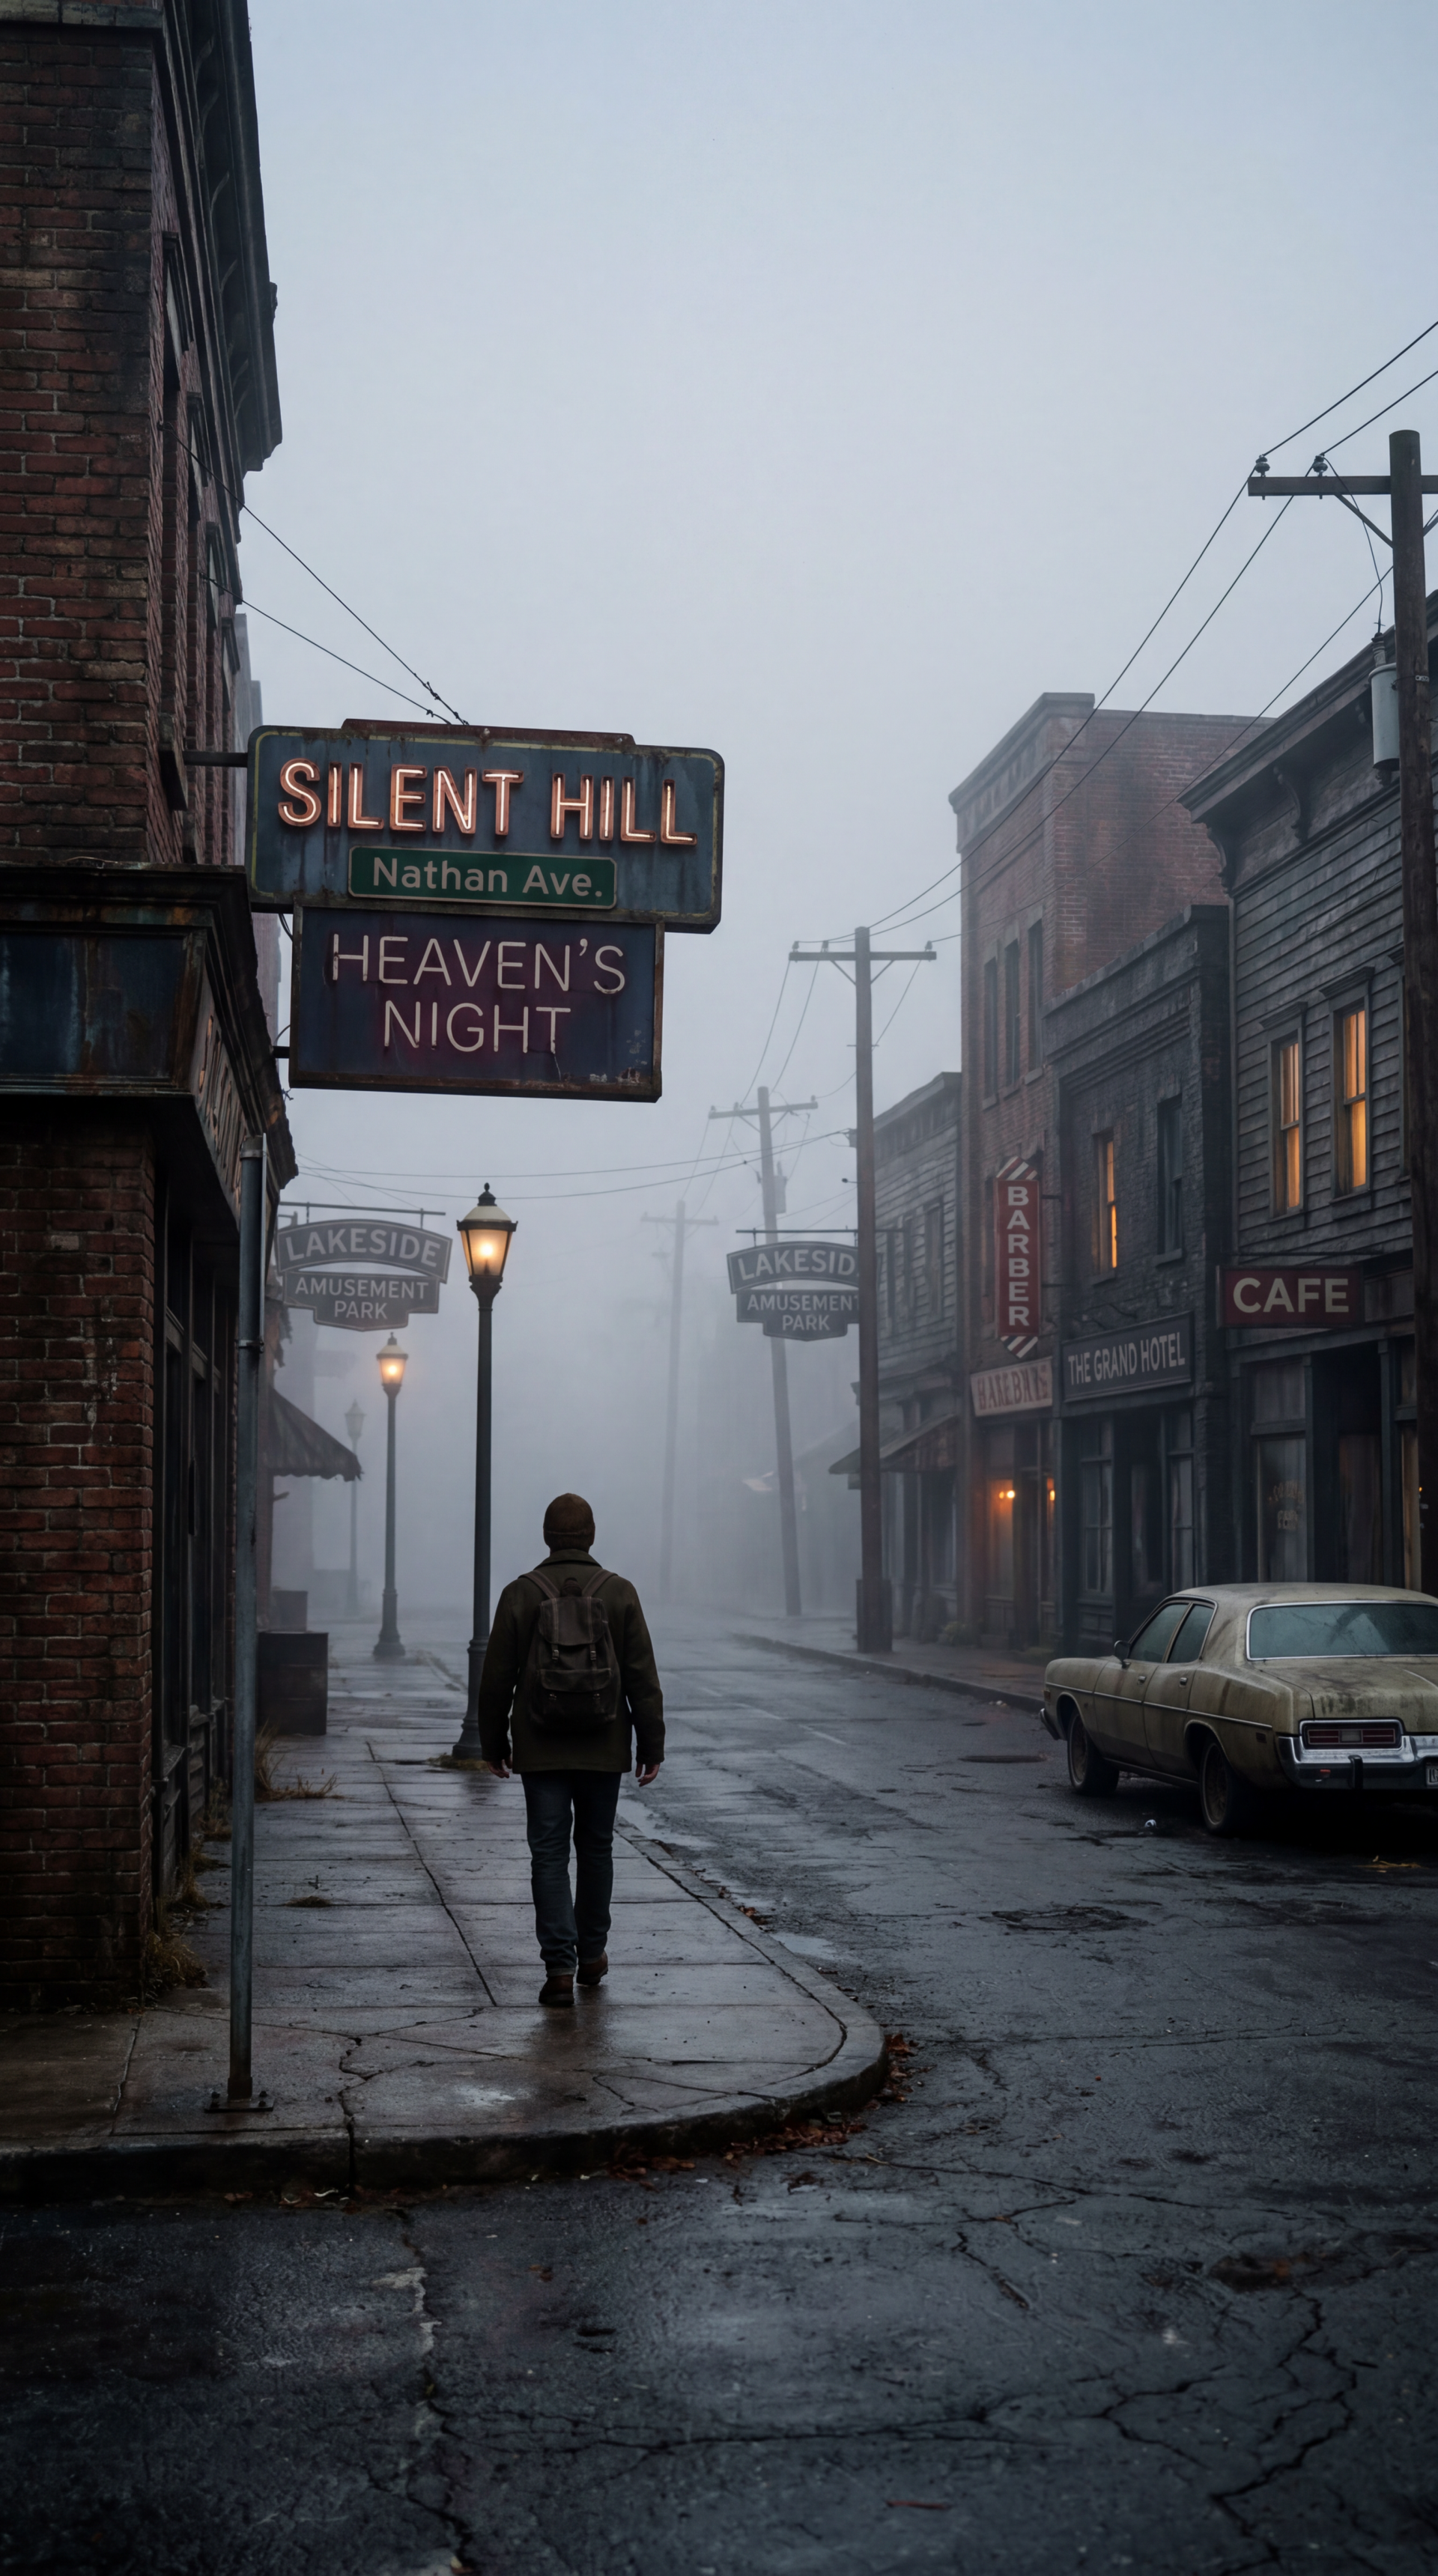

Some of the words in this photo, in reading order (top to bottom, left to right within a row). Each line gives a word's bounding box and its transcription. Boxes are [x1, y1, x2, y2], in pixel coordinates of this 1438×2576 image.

[278, 758, 524, 835] SILENT
[550, 772, 697, 845] HILL
[373, 857, 508, 893] Nathan
[522, 865, 602, 897] Ave.
[333, 934, 625, 994] HEAVEN'S
[383, 1000, 571, 1054] NIGHT
[285, 1228, 441, 1267] LAKESIDE
[738, 1249, 859, 1281] LAKESID
[1007, 1185, 1031, 1327] BARBER
[295, 1277, 428, 1299] AMUSEMENT
[1233, 1277, 1350, 1313] CAFE
[333, 1300, 388, 1319] PARK
[782, 1314, 831, 1331] PARK
[1068, 1352, 1091, 1385] THE
[1093, 1342, 1138, 1381] GRAND
[1140, 1331, 1186, 1373] HOTEL
